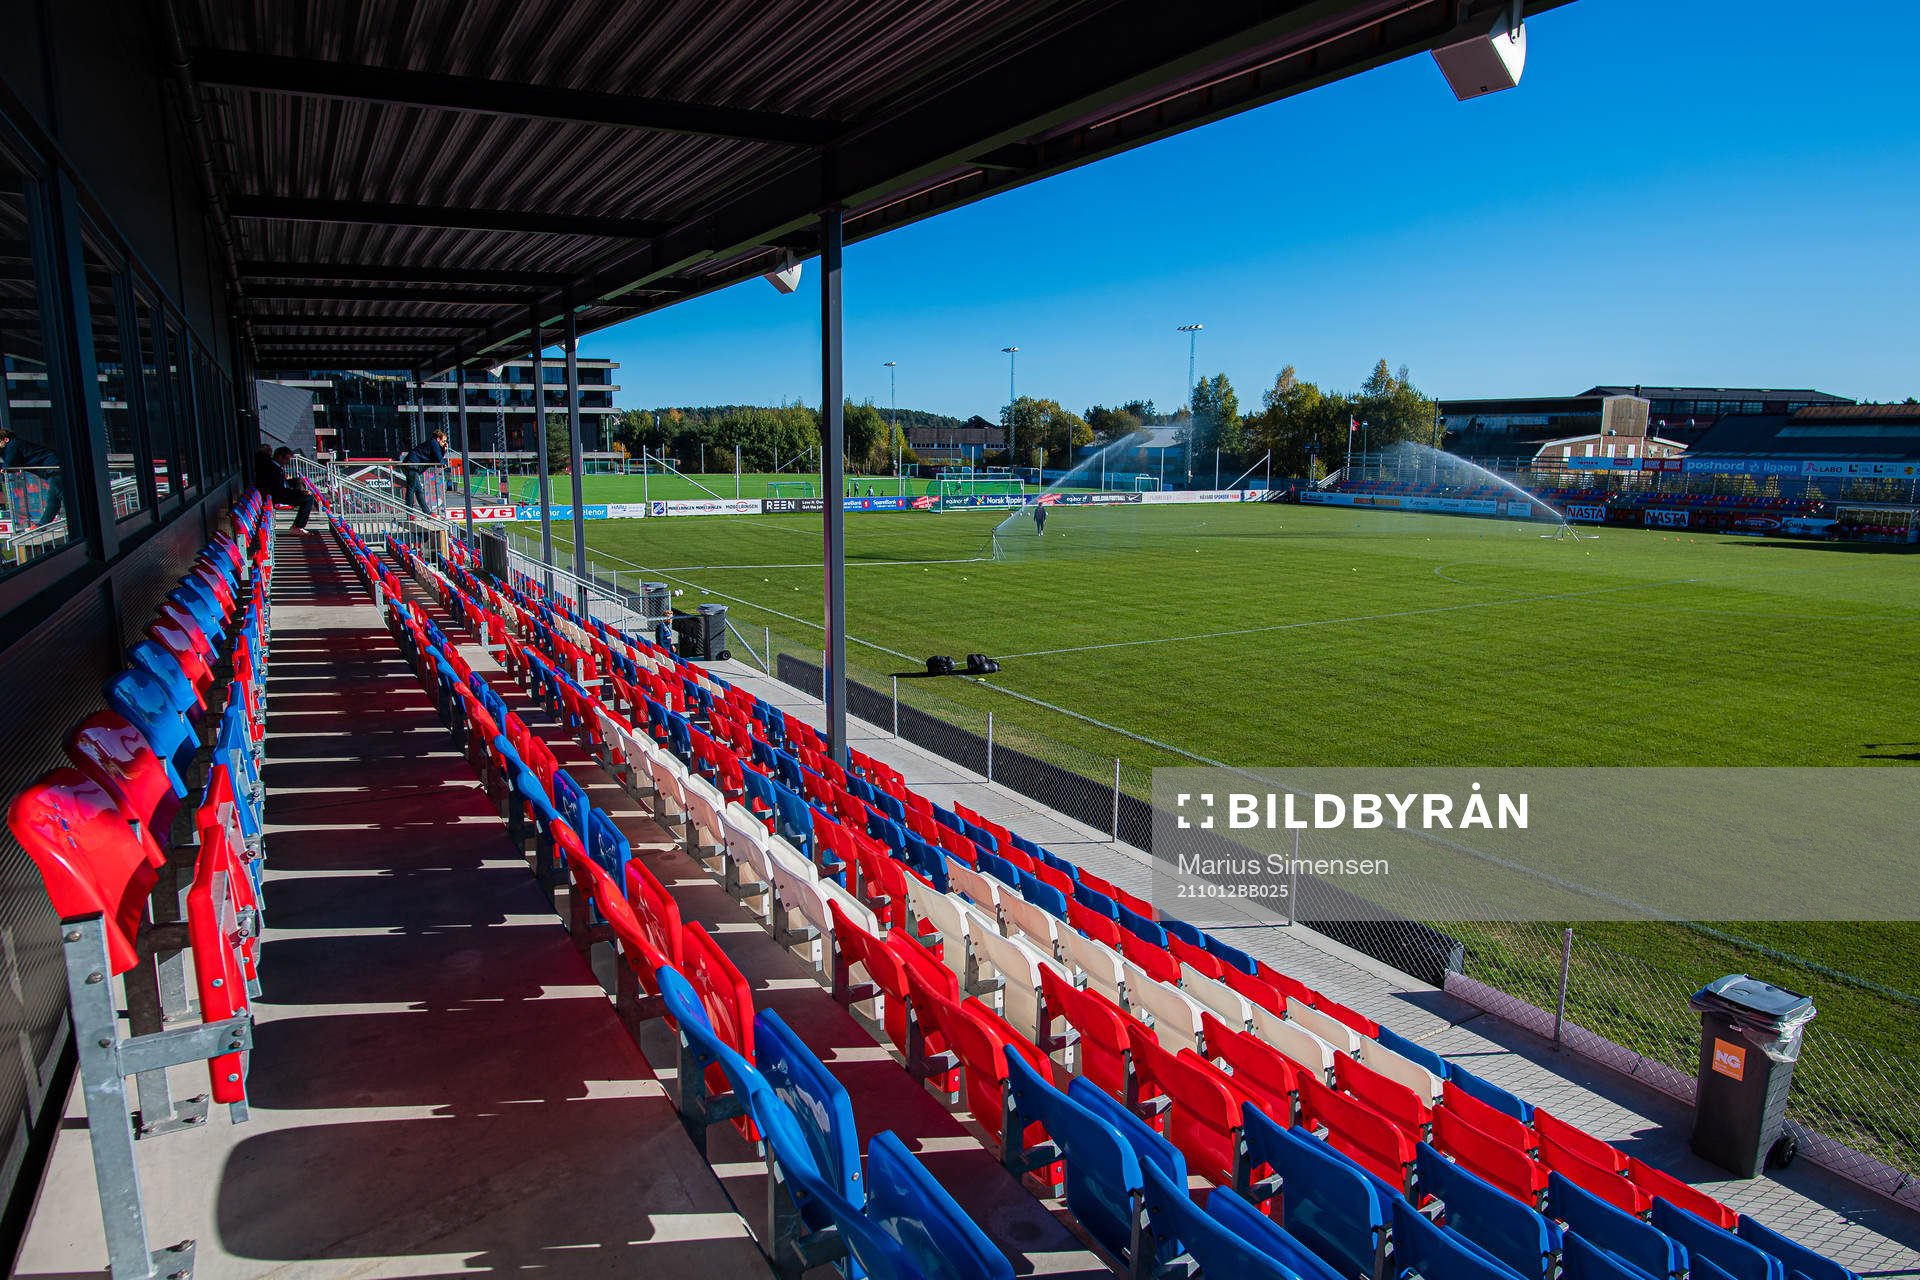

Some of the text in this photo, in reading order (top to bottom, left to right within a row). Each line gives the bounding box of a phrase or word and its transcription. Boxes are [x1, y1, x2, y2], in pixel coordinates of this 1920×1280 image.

[1687, 461, 1745, 471] postnord
[1764, 462, 1797, 473] ligaen
[766, 500, 795, 510] REEN
[1567, 506, 1605, 520] NASTA
[1646, 511, 1687, 526] NASTA
[1715, 1049, 1741, 1068] NG
